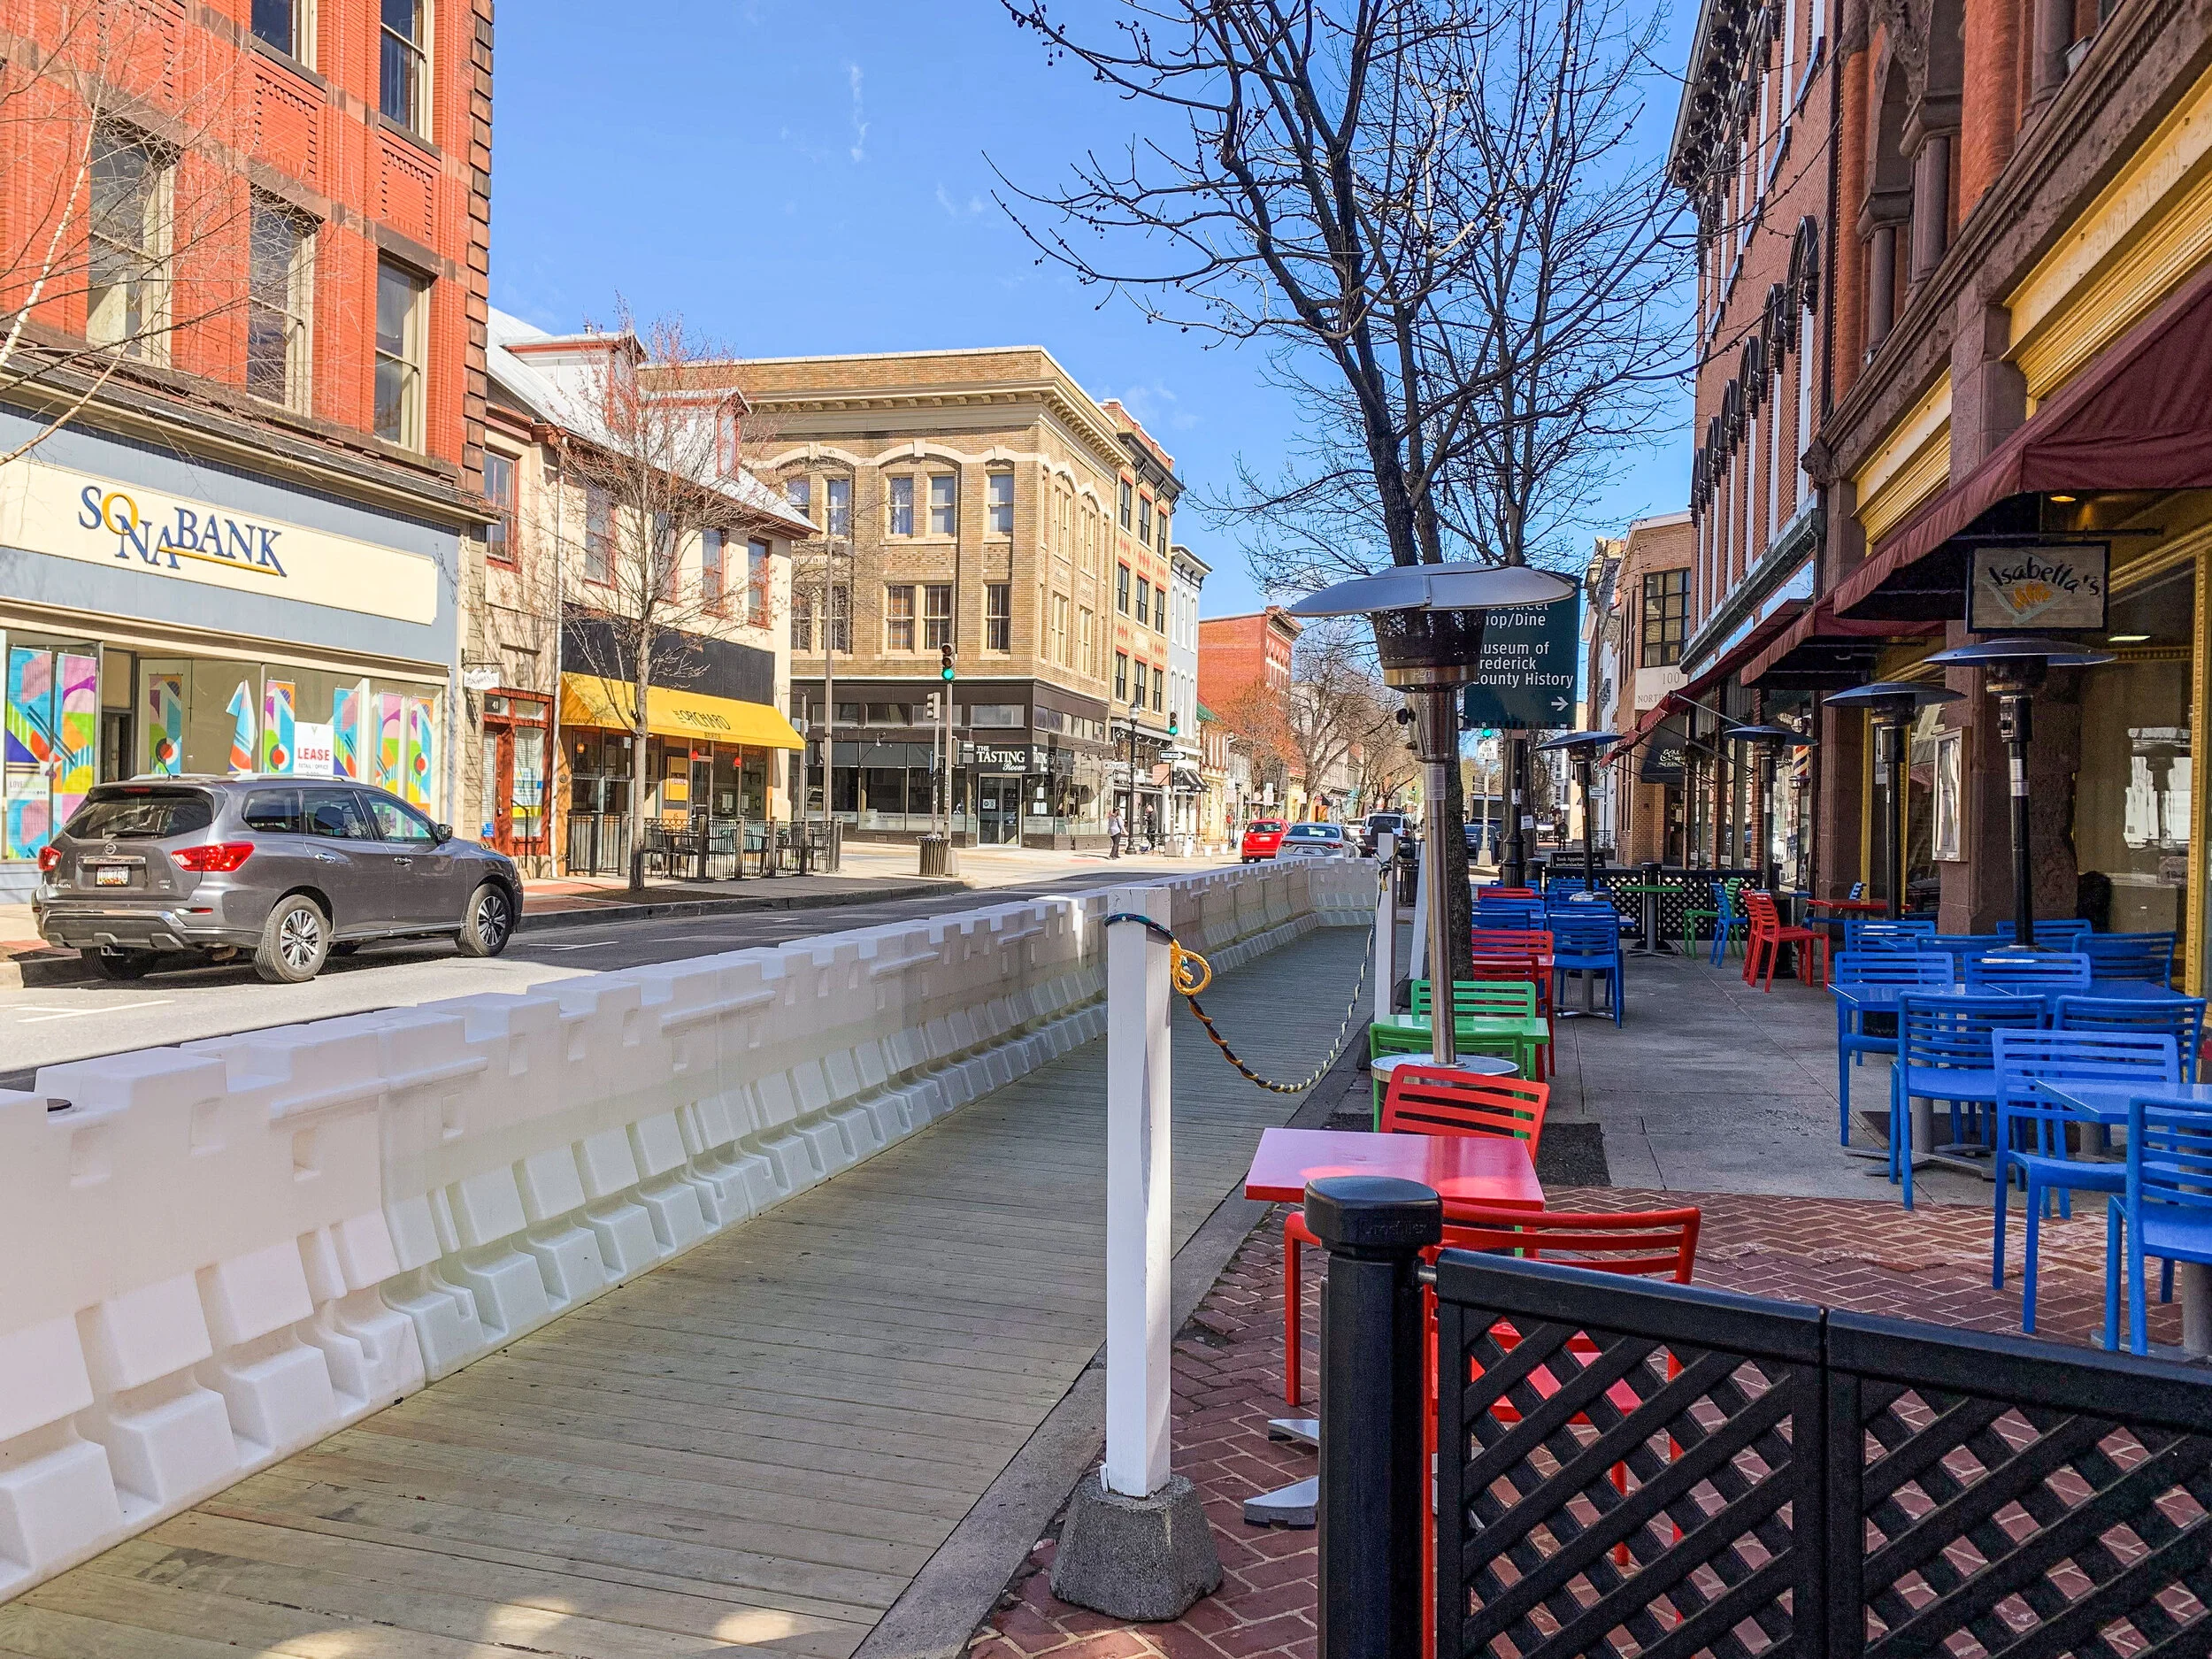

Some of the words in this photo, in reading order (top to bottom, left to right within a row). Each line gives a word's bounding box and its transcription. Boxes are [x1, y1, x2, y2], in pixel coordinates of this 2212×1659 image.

[1988, 557, 2101, 596] Isabella's
[1480, 643, 1529, 655] useum
[1535, 641, 1550, 655] of
[1479, 657, 1537, 670] rederick
[1525, 672, 1574, 689] History
[1663, 672, 1680, 684] 100
[491, 700, 499, 710] 41
[680, 710, 731, 730] ORCHARD
[297, 747, 330, 761] LEASE
[976, 751, 1025, 763] TASTING
[1002, 761, 1027, 772] Room
